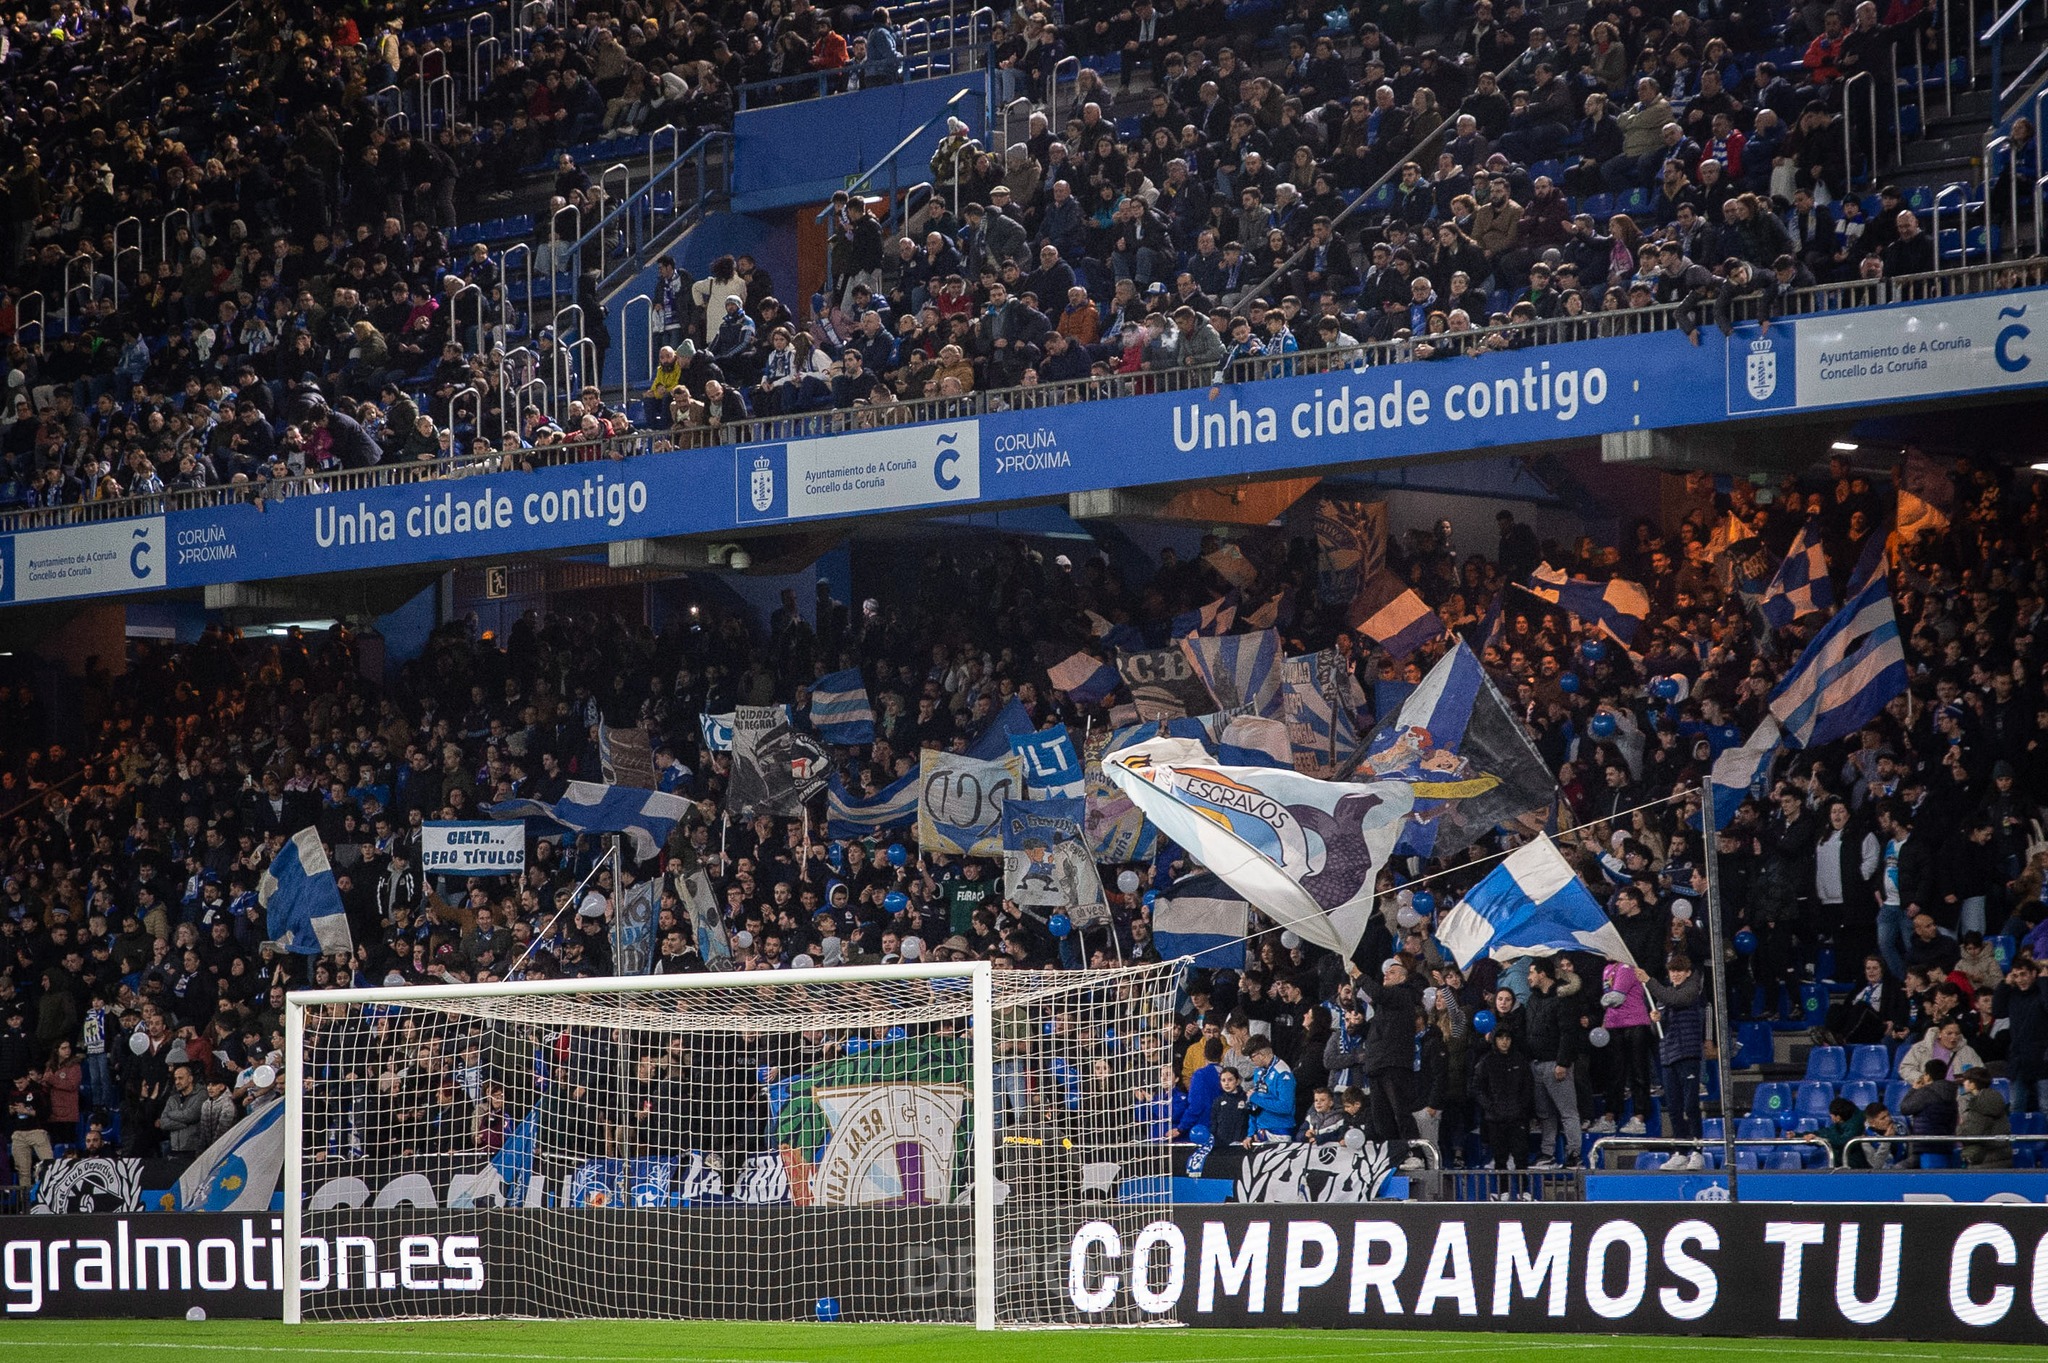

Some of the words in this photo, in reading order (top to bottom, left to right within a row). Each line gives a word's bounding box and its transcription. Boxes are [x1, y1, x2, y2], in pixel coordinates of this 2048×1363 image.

[1820, 346, 1899, 366] Ayuntamiento
[1902, 342, 1916, 355] de
[1919, 341, 1928, 352] A
[1931, 336, 1971, 351] Coruña
[1821, 363, 1867, 380] Concello
[1870, 360, 1884, 374] da
[1887, 358, 1927, 372] Coruña
[1172, 386, 1276, 453] Unha
[1289, 378, 1430, 439] cidade
[1445, 362, 1609, 421] contigo
[995, 428, 1056, 453] CORUÑA
[805, 465, 864, 481] Ayuntamiento
[866, 463, 877, 474] de
[879, 462, 886, 472] A
[887, 458, 917, 471] Coruña
[805, 481, 841, 495] Concello
[842, 479, 853, 491] da
[855, 476, 885, 490] Coruña
[314, 501, 395, 550] Unha
[406, 492, 512, 539] cidade
[523, 475, 647, 527] contigo
[177, 524, 226, 545] CORUÑA
[29, 555, 75, 569] Ayuntamiento
[76, 554, 85, 563] de
[86, 554, 92, 562] A
[93, 551, 117, 561] Coruña
[29, 569, 57, 581] Concello
[58, 568, 67, 577] da
[68, 565, 91, 576] Coruña
[1187, 778, 1289, 829] ESCRAVOS
[447, 831, 504, 844] CELTA...
[464, 848, 524, 864] TÍTULOS
[1003, 1136, 1042, 1145] PROSEGUR
[64, 1169, 84, 1187] Club
[83, 1161, 115, 1184] Deportivo
[4, 1219, 484, 1313] gralmotion.es
[1069, 1219, 1721, 1321] COMPRAMOS
[1764, 1222, 1903, 1324] TU
[1949, 1222, 2048, 1326] C
